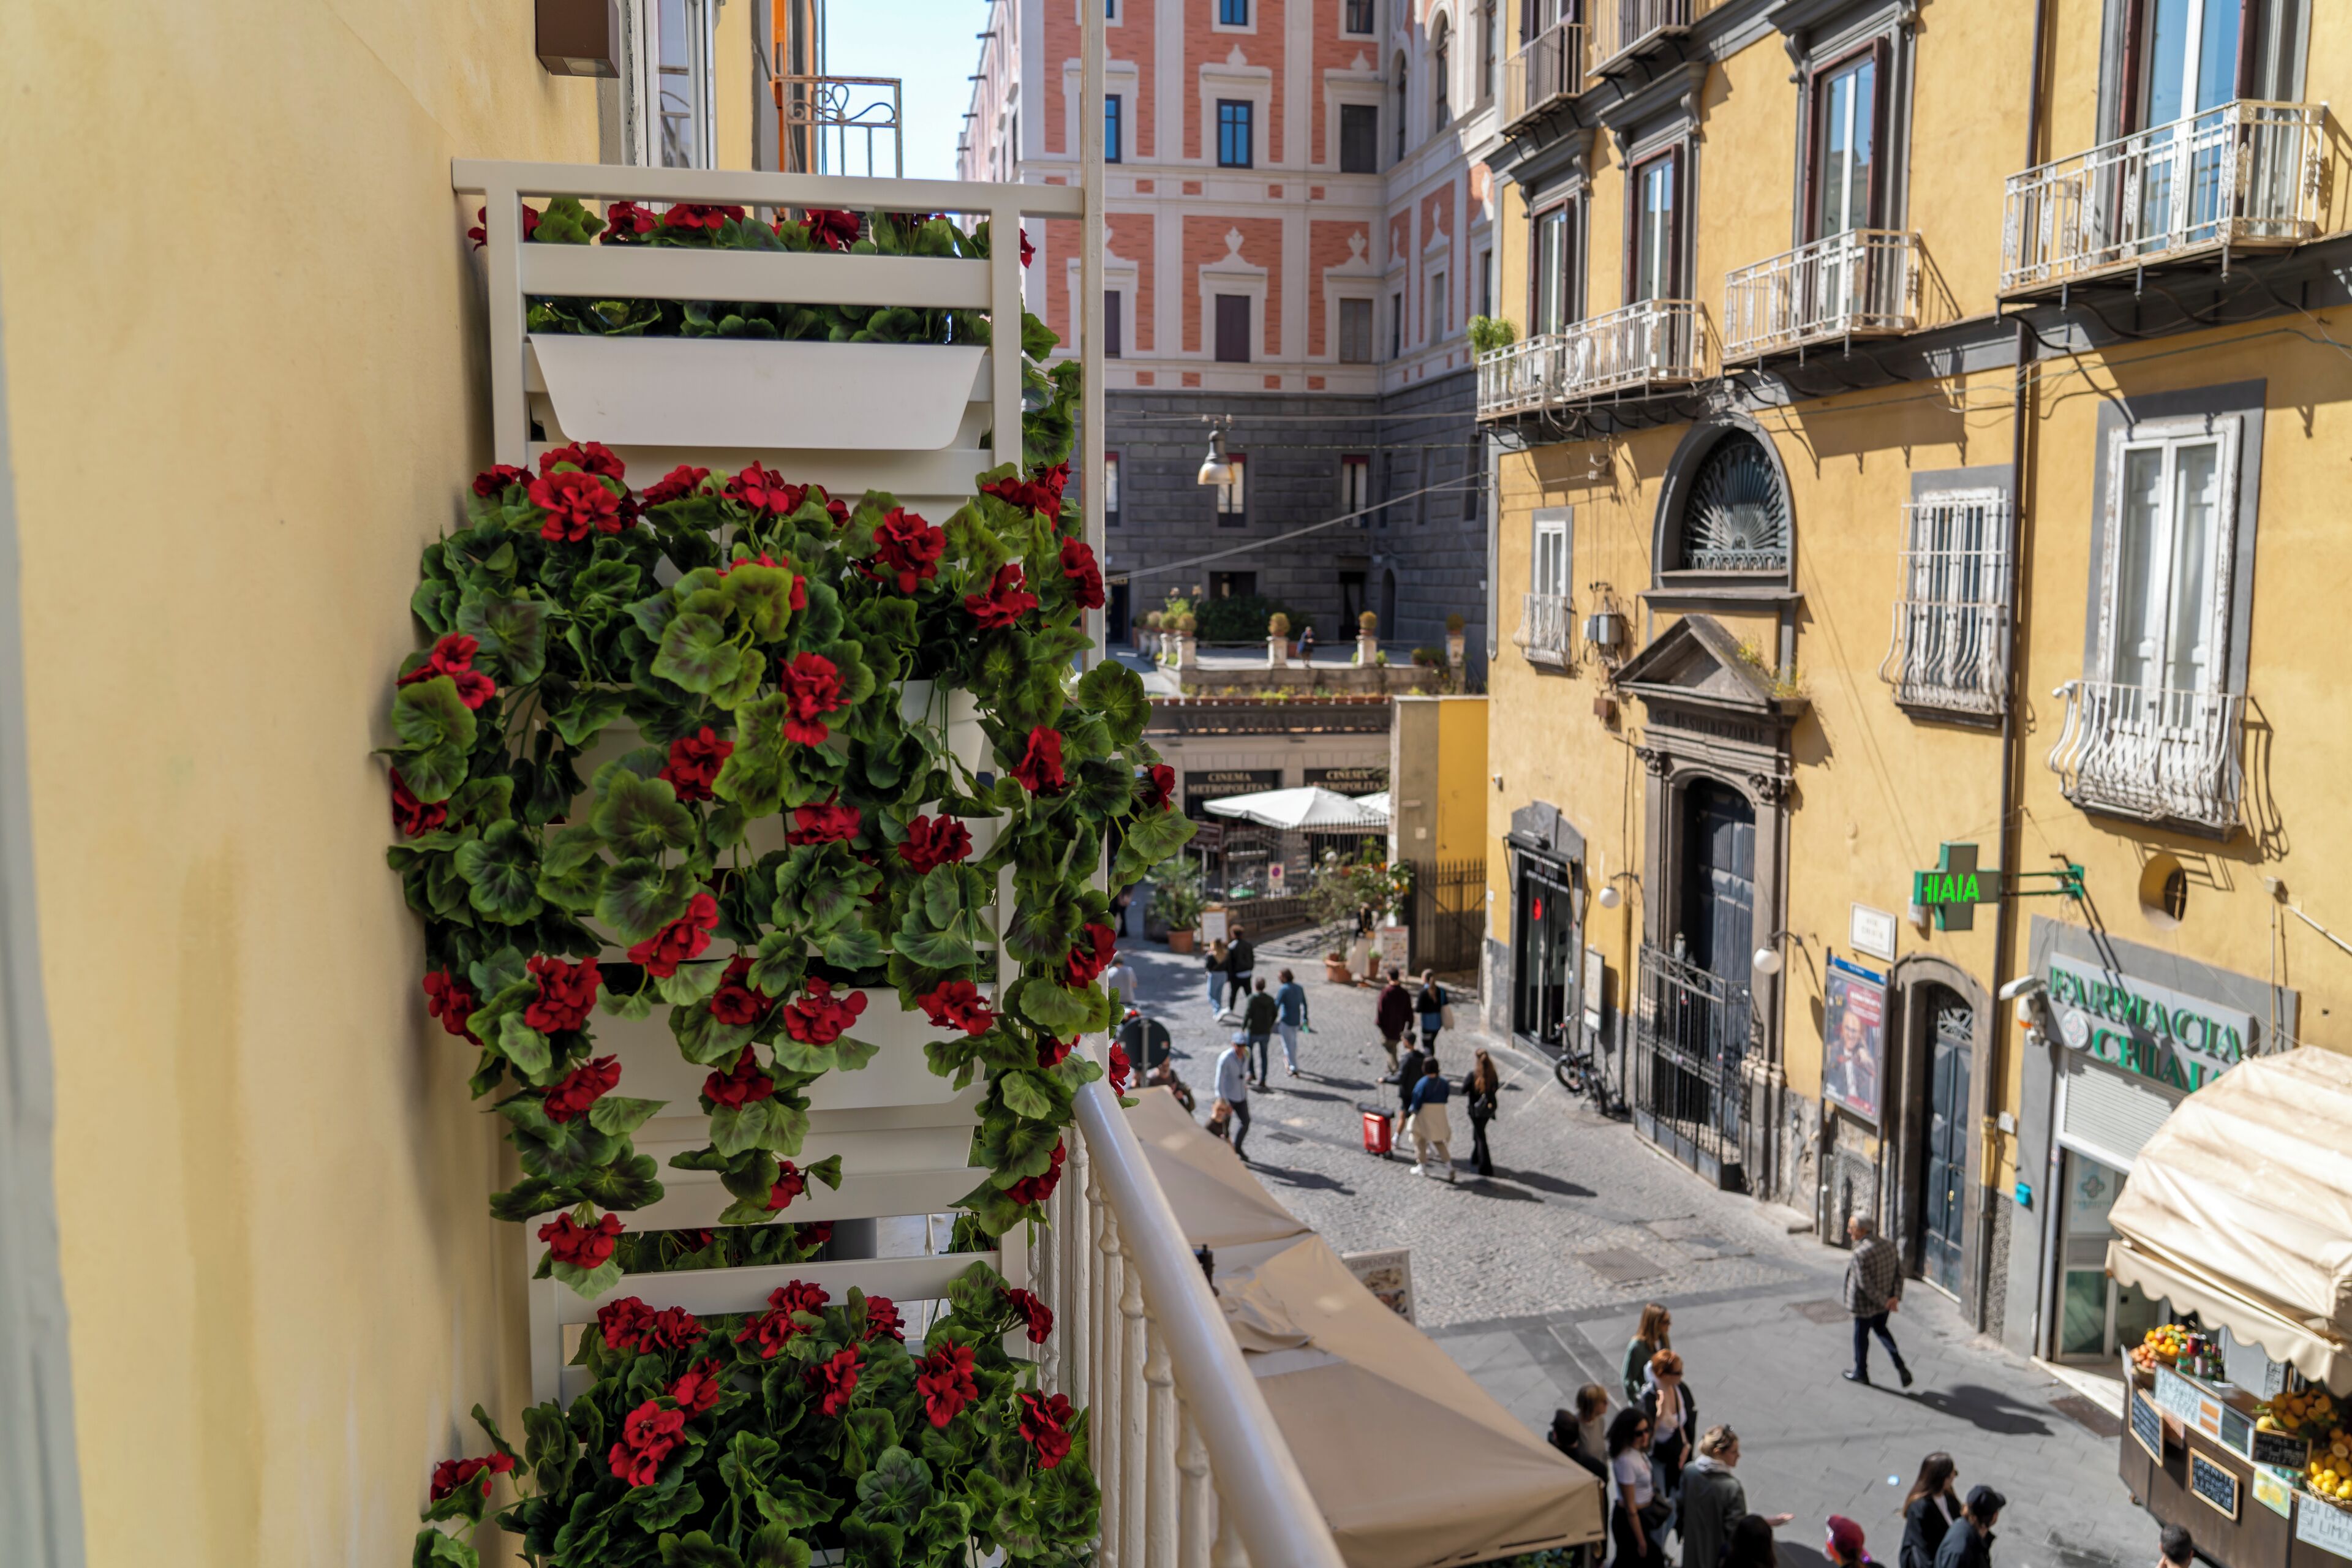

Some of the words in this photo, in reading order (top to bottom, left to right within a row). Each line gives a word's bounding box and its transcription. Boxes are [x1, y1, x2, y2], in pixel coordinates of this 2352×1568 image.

[1207, 772, 1252, 783] CINEMA
[1325, 770, 1369, 780] CINEMA
[1187, 783, 1272, 794] METROPOLITAN
[2048, 966, 2241, 1061] FARMACIA
[2092, 1028, 2221, 1093] CHIAI
